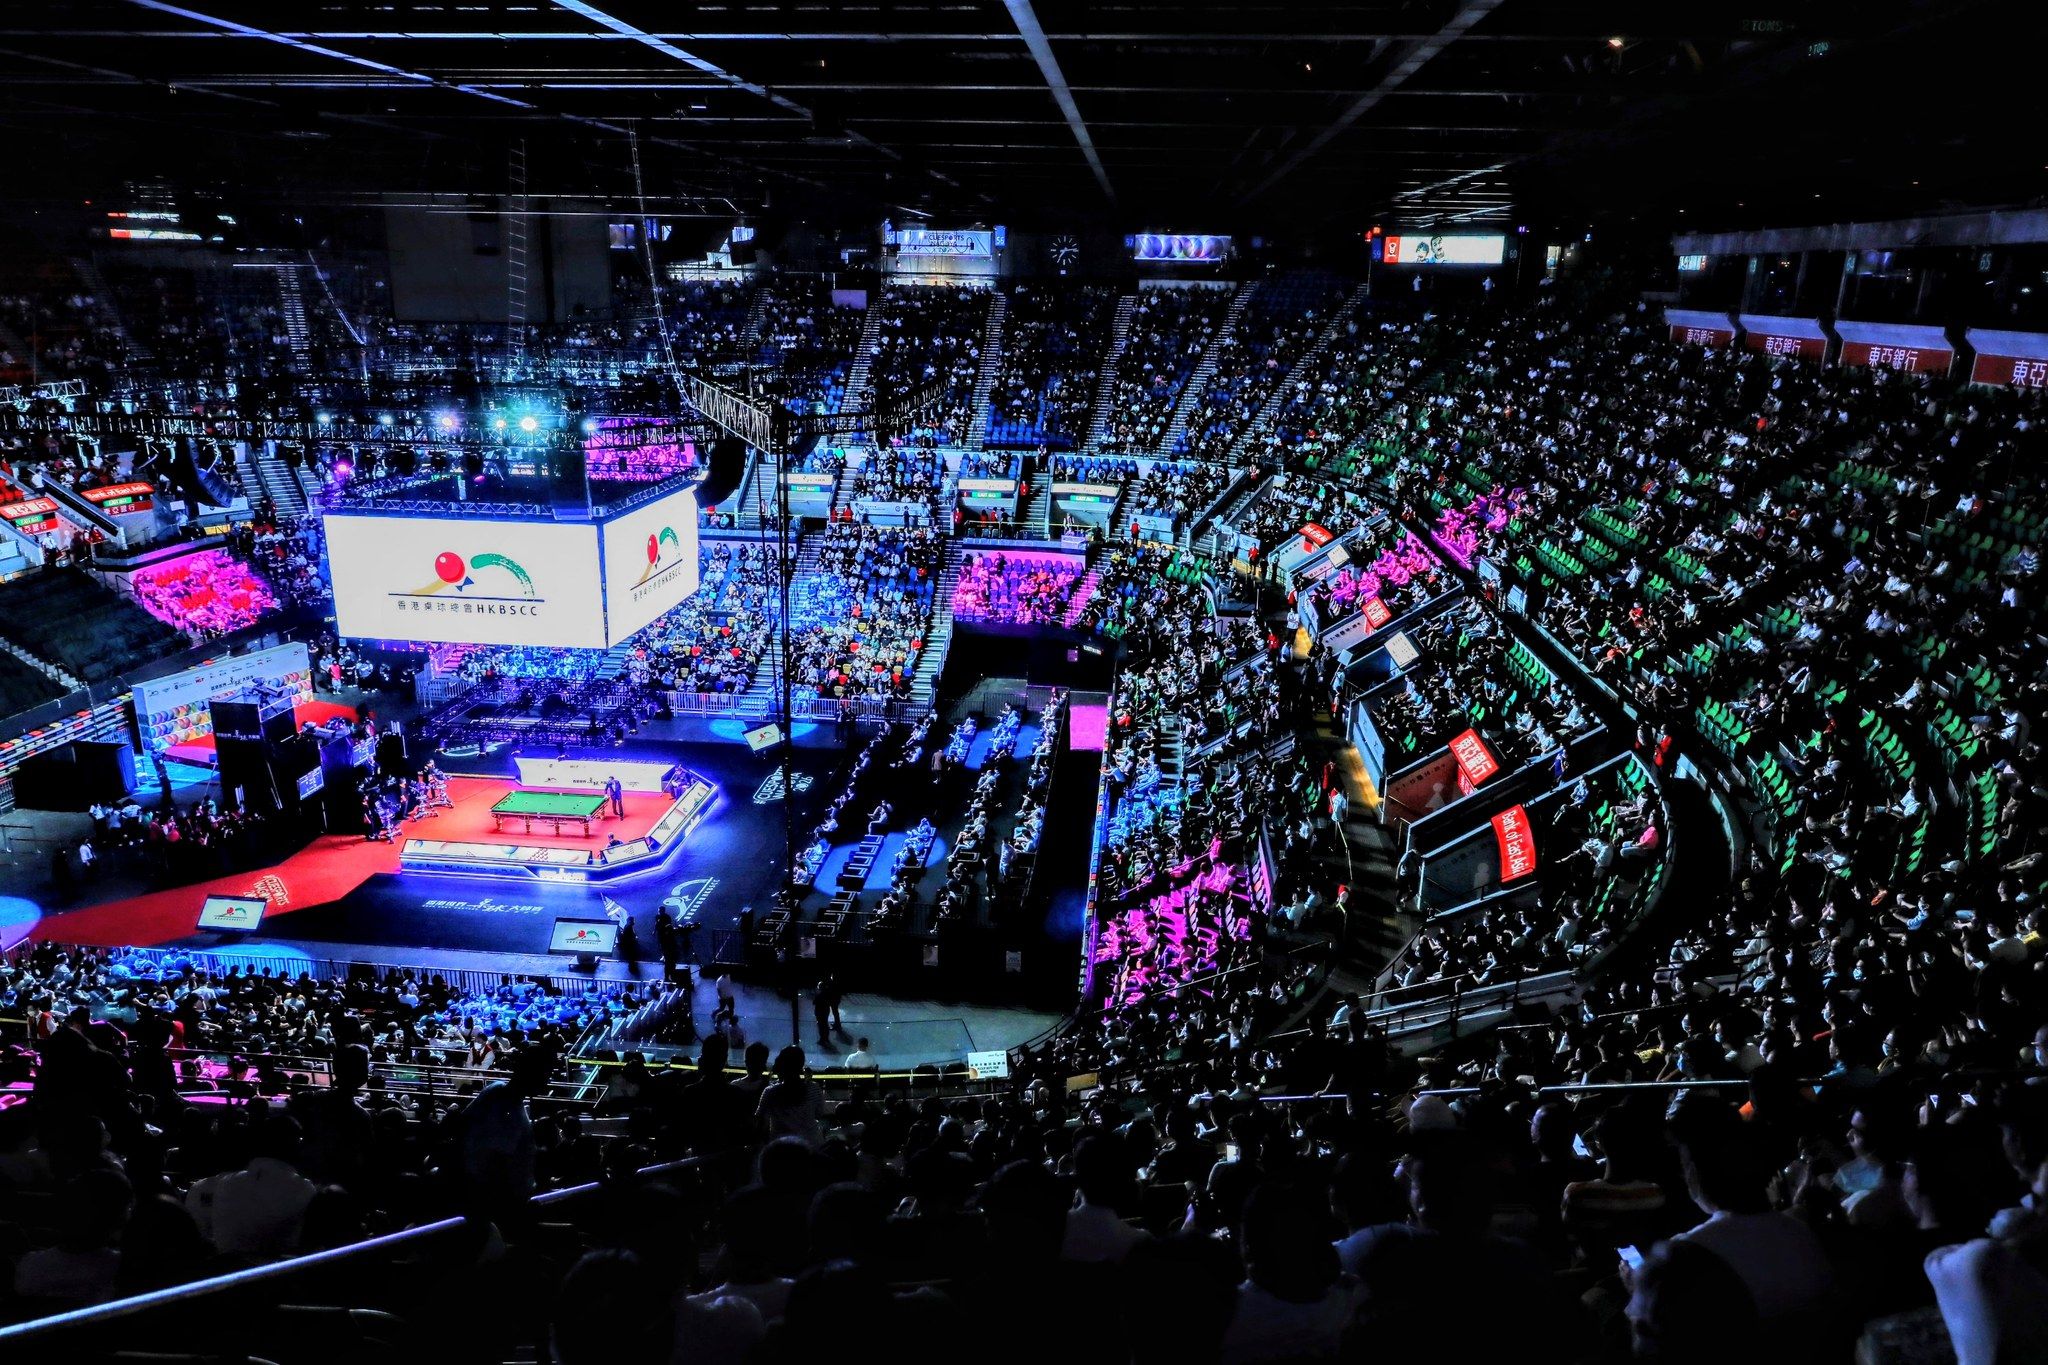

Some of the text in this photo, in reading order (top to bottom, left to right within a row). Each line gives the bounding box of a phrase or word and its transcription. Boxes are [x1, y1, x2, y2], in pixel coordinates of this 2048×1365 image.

[1764, 336, 1802, 357] 東亞銀行
[1868, 346, 1919, 372] 東亞銀行
[2011, 360, 2048, 388] 東亞
[476, 603, 538, 616] HKBSCC
[1453, 734, 1493, 779] 東亞銀行
[1502, 810, 1521, 835] Bank
[1505, 830, 1519, 842] of
[1508, 837, 1524, 859] East
